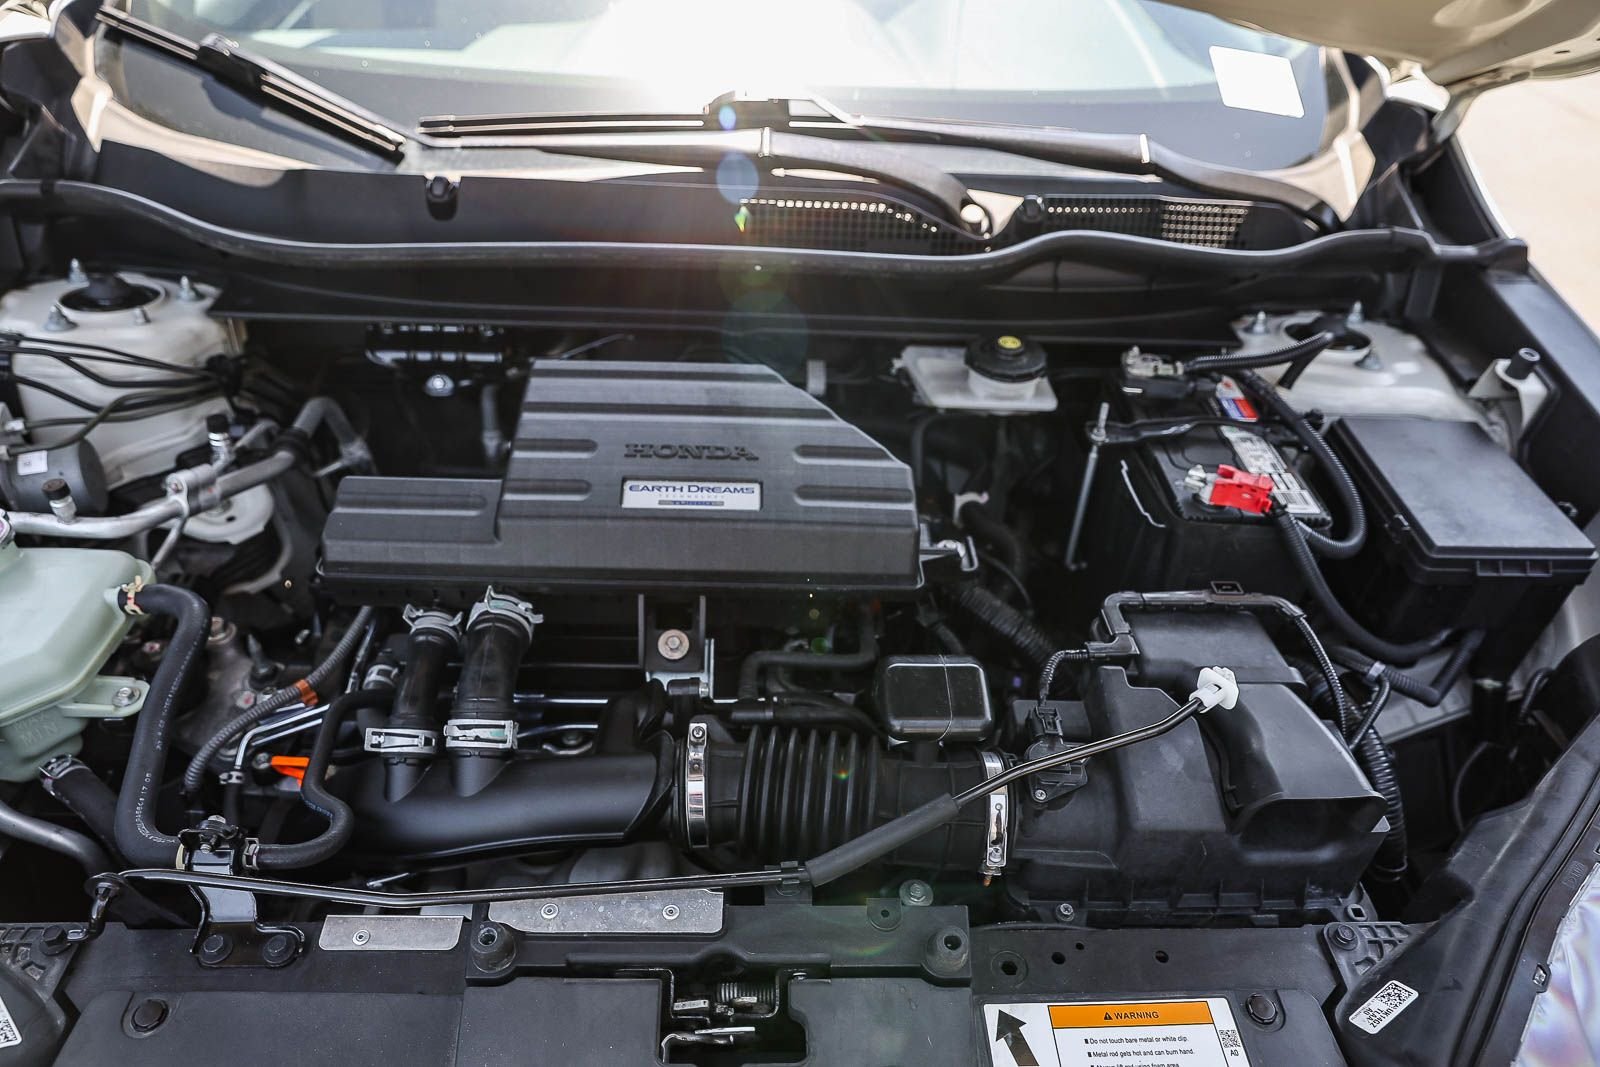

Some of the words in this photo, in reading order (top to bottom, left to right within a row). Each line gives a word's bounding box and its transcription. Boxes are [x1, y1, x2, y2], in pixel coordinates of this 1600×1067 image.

[624, 444, 759, 460] HONDA
[628, 484, 683, 493] EARTH
[687, 484, 755, 494] DREAMS
[1114, 1011, 1160, 1019] WARNING
[1119, 1050, 1131, 1058] gets
